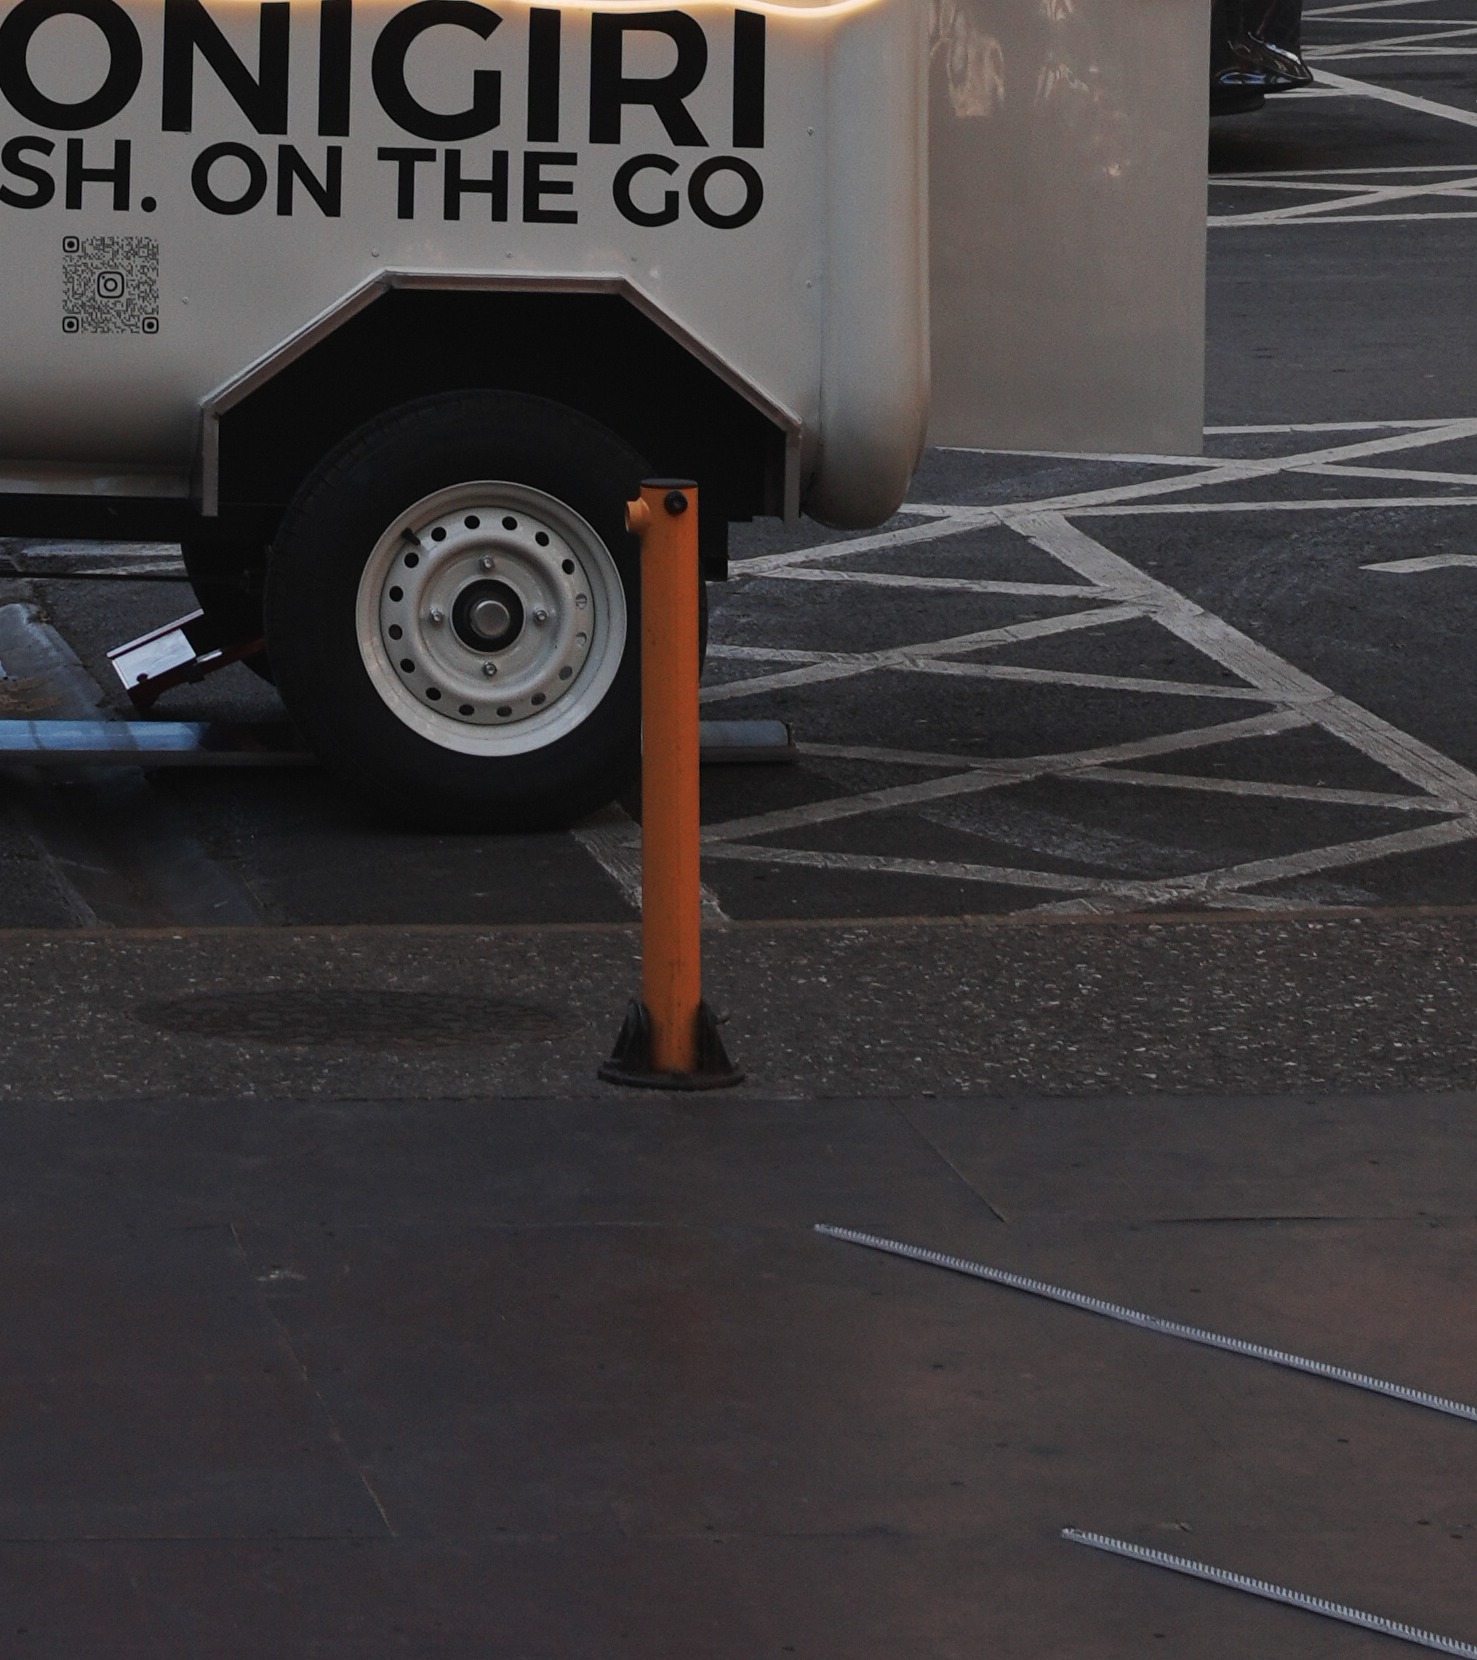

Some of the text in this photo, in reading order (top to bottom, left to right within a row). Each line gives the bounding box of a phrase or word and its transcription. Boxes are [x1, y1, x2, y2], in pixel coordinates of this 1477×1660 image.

[189, 141, 346, 219] ON
[377, 146, 578, 225] THE
[612, 152, 765, 230] GO
